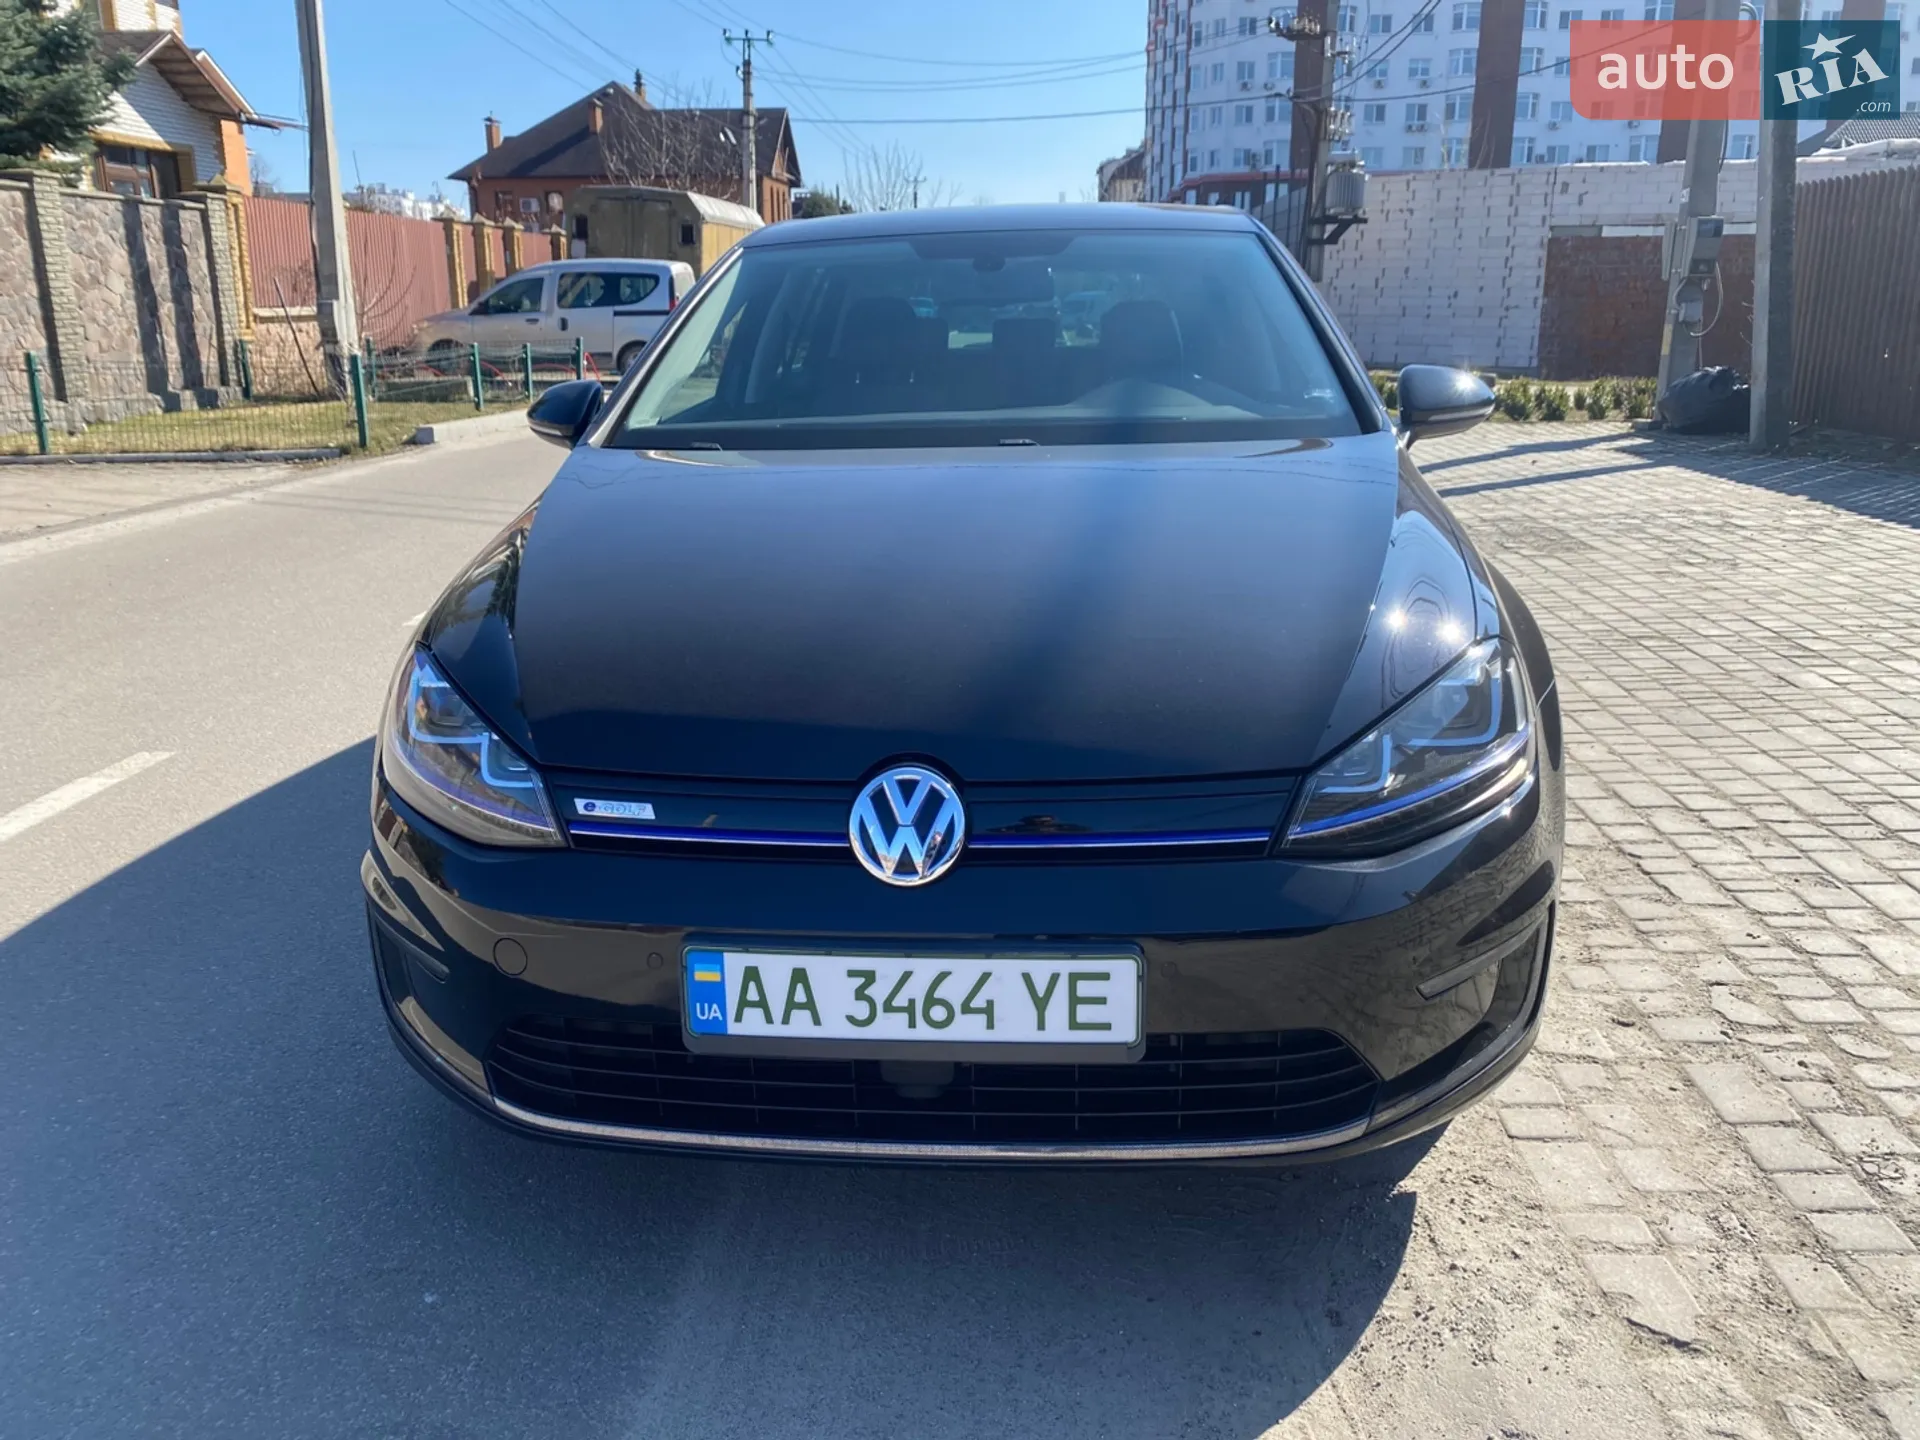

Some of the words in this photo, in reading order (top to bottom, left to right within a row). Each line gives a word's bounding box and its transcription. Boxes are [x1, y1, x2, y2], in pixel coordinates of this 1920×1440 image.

[696, 1003, 722, 1020] UA
[734, 966, 821, 1026] AA
[845, 970, 995, 1030] 3464
[1021, 972, 1112, 1031] YE
